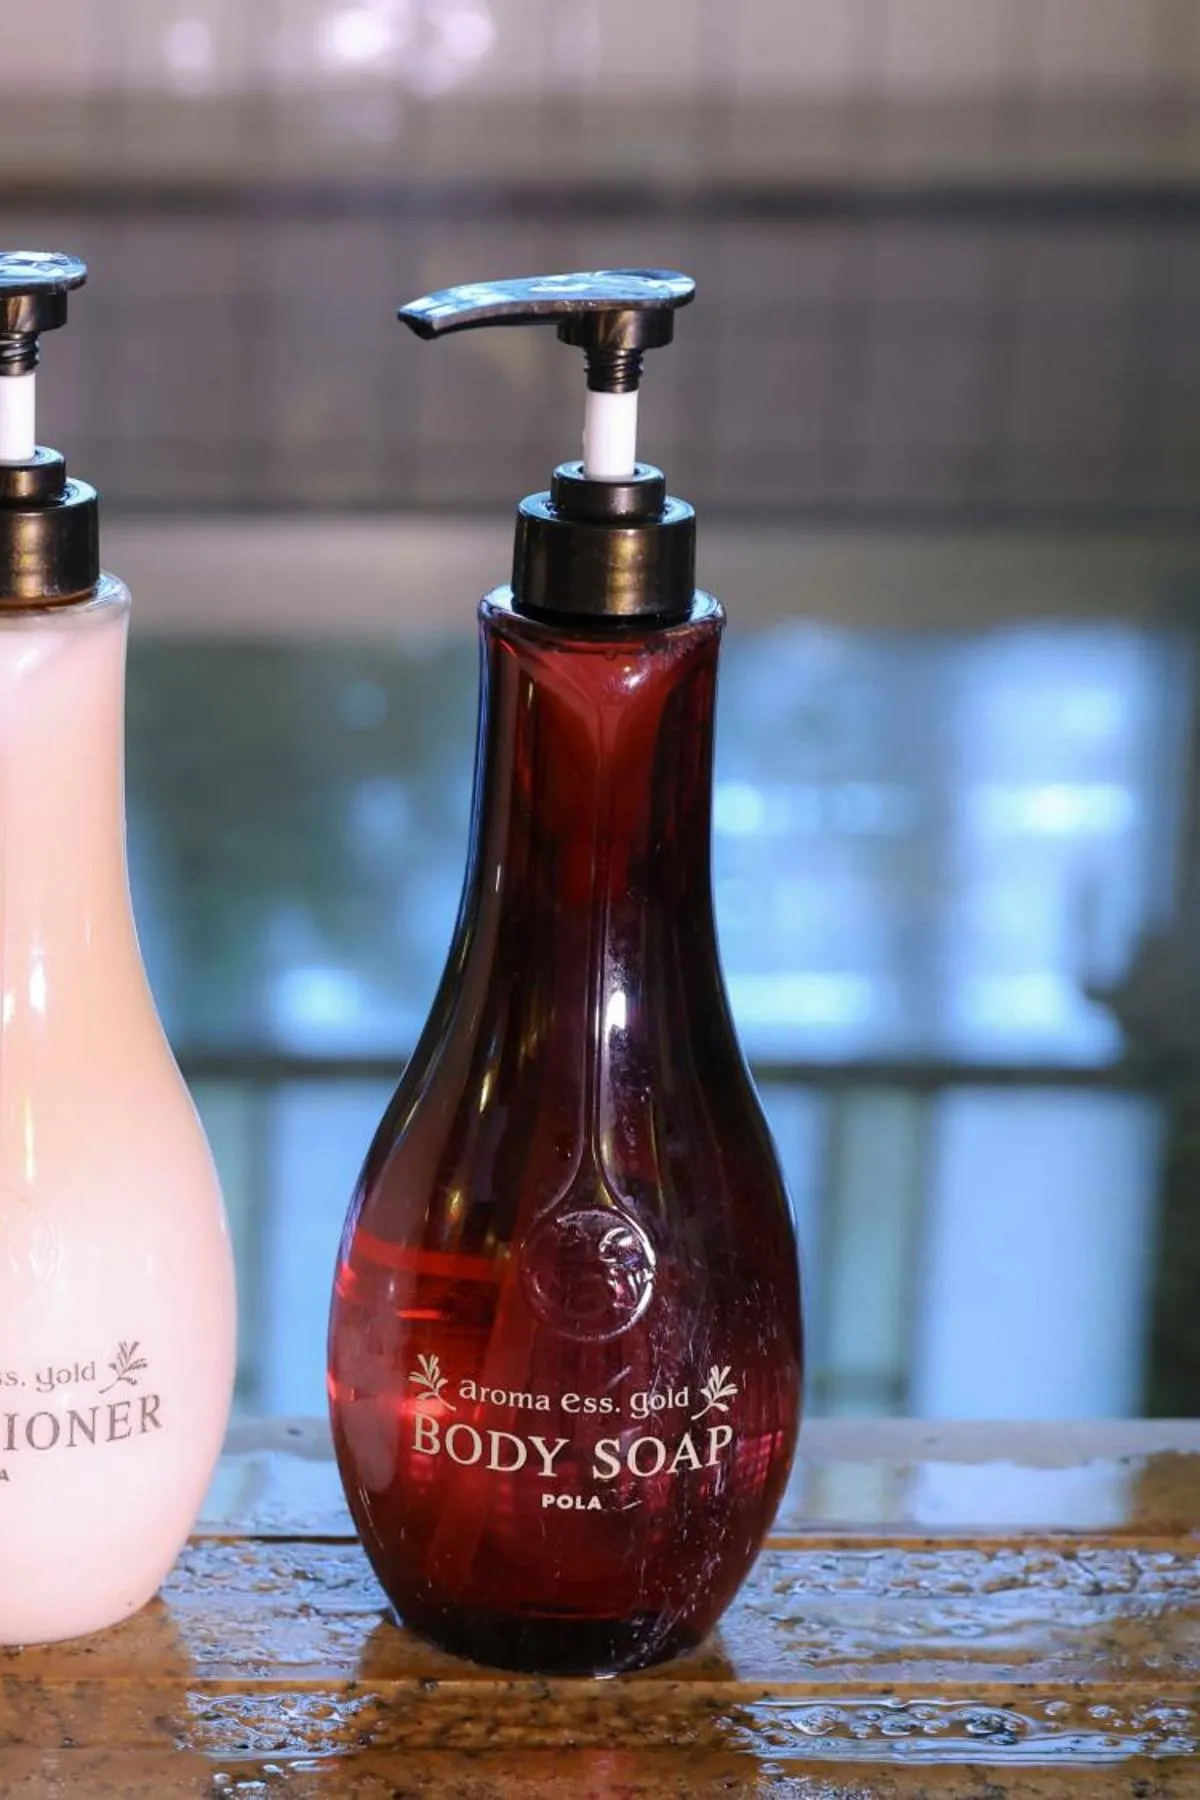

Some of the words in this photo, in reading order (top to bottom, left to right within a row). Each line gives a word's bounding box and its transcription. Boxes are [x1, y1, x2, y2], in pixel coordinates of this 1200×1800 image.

[35, 1361, 97, 1393] gold
[459, 1378, 551, 1412] aroma
[560, 1389, 621, 1415] ess.
[630, 1386, 690, 1420] gold
[411, 1411, 570, 1478] BODY
[592, 1424, 734, 1480] SOAP
[541, 1493, 602, 1511] POLA
